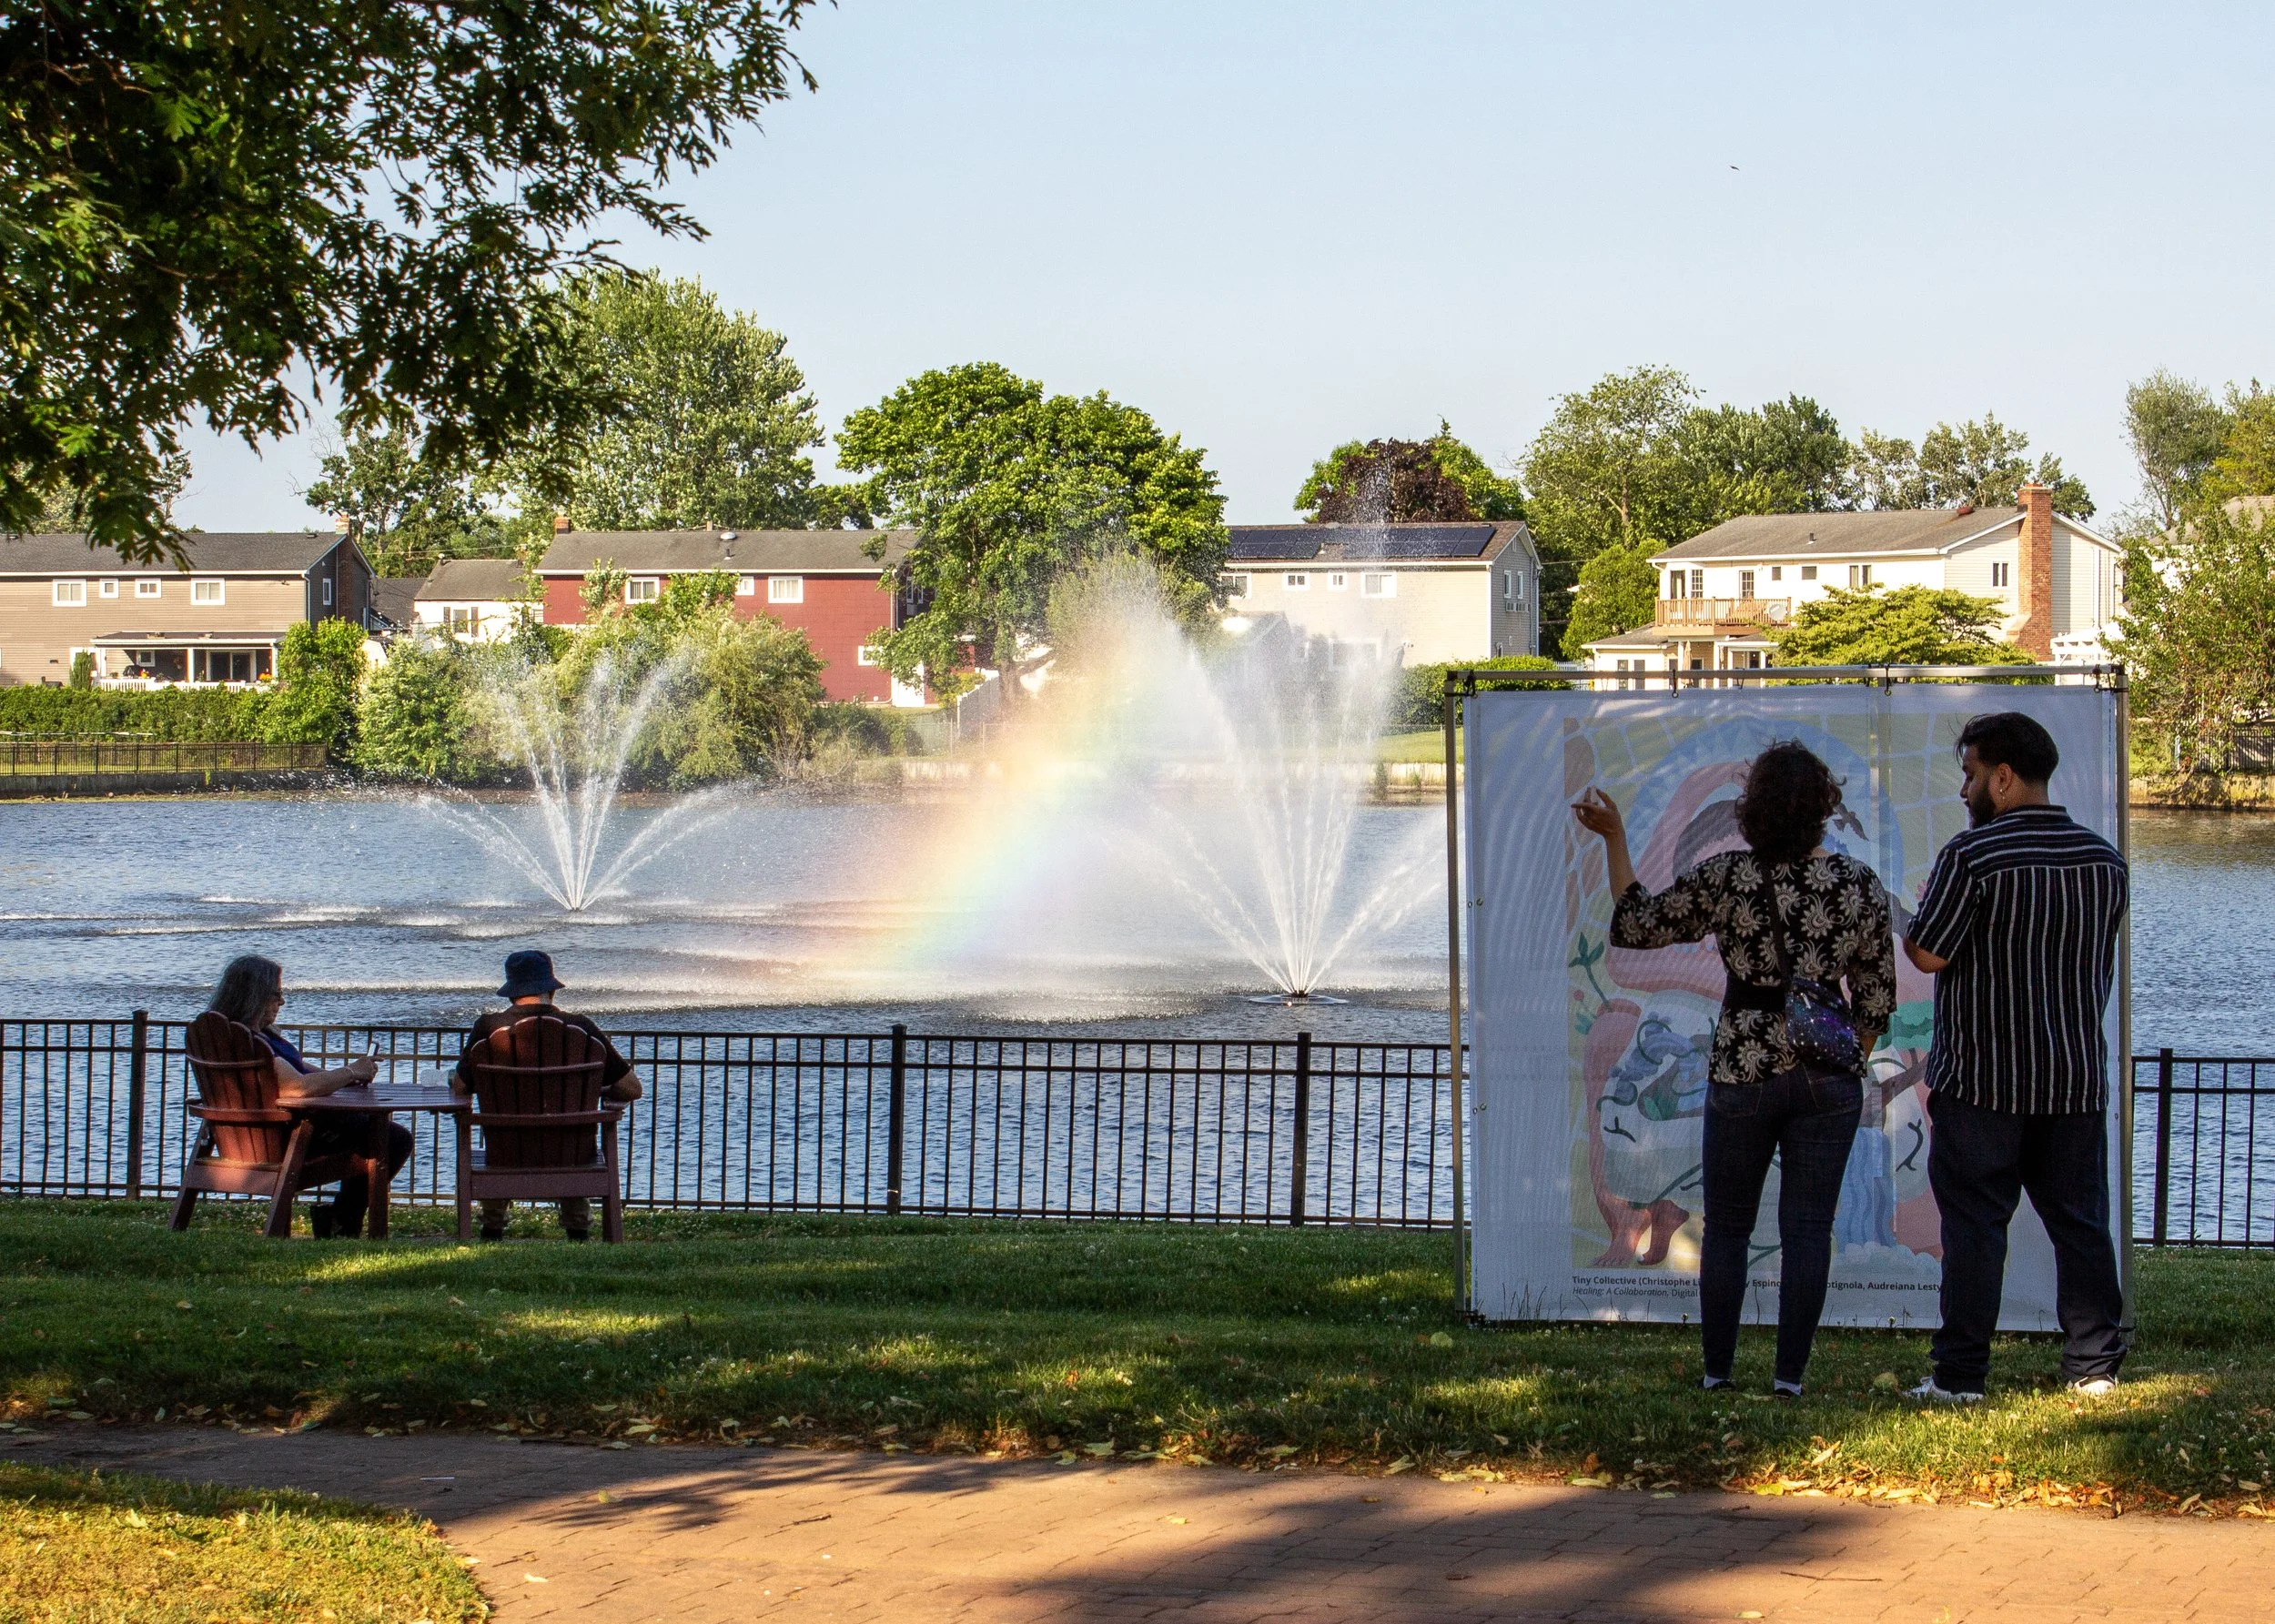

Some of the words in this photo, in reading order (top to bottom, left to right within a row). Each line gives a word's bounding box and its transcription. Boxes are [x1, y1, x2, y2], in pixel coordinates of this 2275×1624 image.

[1572, 1276, 1591, 1286] Tiny
[1593, 1276, 1636, 1285] Collective
[1639, 1276, 1691, 1289] (Christophe
[1753, 1279, 1781, 1289] Espino
[1826, 1281, 1865, 1290] otignola,
[1867, 1282, 1915, 1291] Audreiana
[1917, 1283, 1941, 1293] Lesty
[1572, 1286, 1604, 1296] Healing:
[1606, 1287, 1613, 1296] A
[1614, 1287, 1669, 1297] Collaboration,
[1672, 1289, 1698, 1299] Digital
